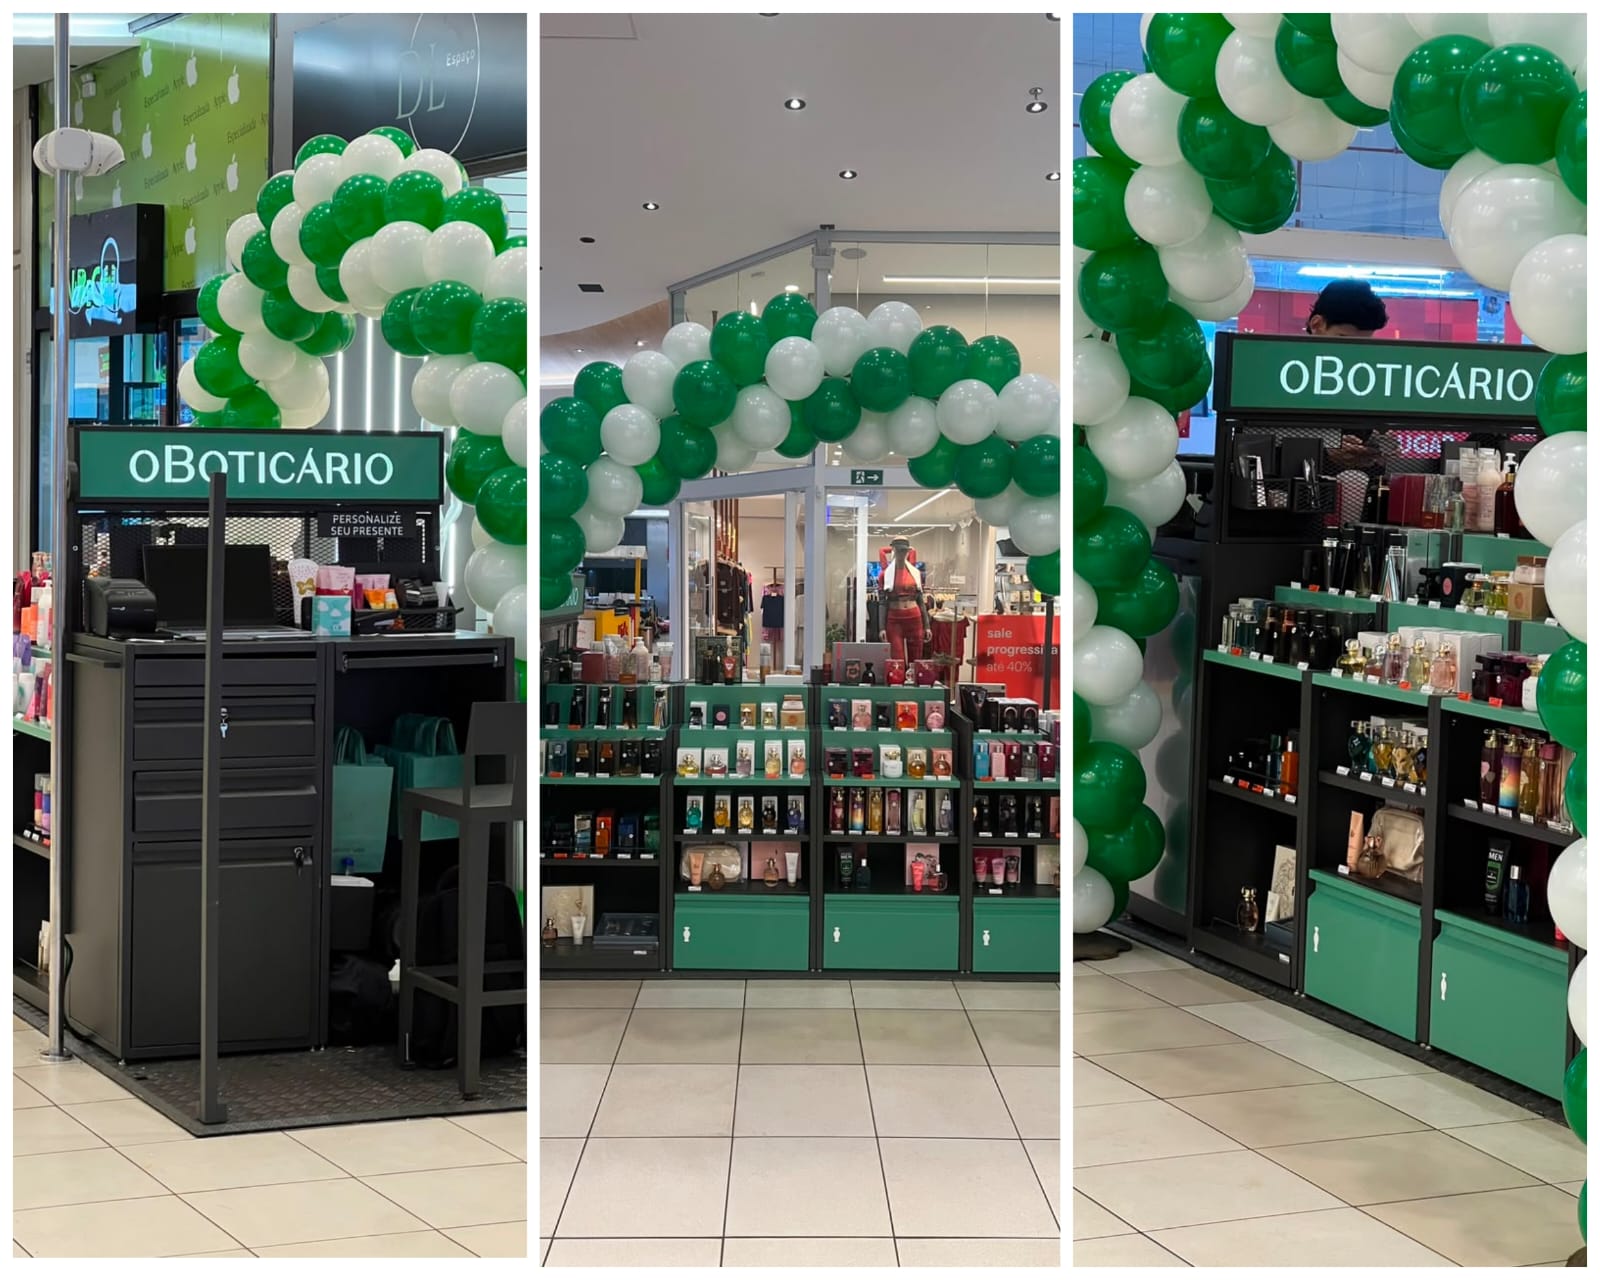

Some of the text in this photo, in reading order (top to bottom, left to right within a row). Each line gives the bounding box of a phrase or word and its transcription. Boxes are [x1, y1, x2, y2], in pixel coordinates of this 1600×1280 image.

[446, 49, 475, 67] Espaço
[332, 514, 402, 525] PERSONALIZE
[331, 526, 404, 536] SEU PRESENTE
[987, 628, 1013, 639] sale
[986, 644, 1058, 656] progressia
[1007, 660, 1032, 672] 40%
[1488, 851, 1503, 861] MEN
